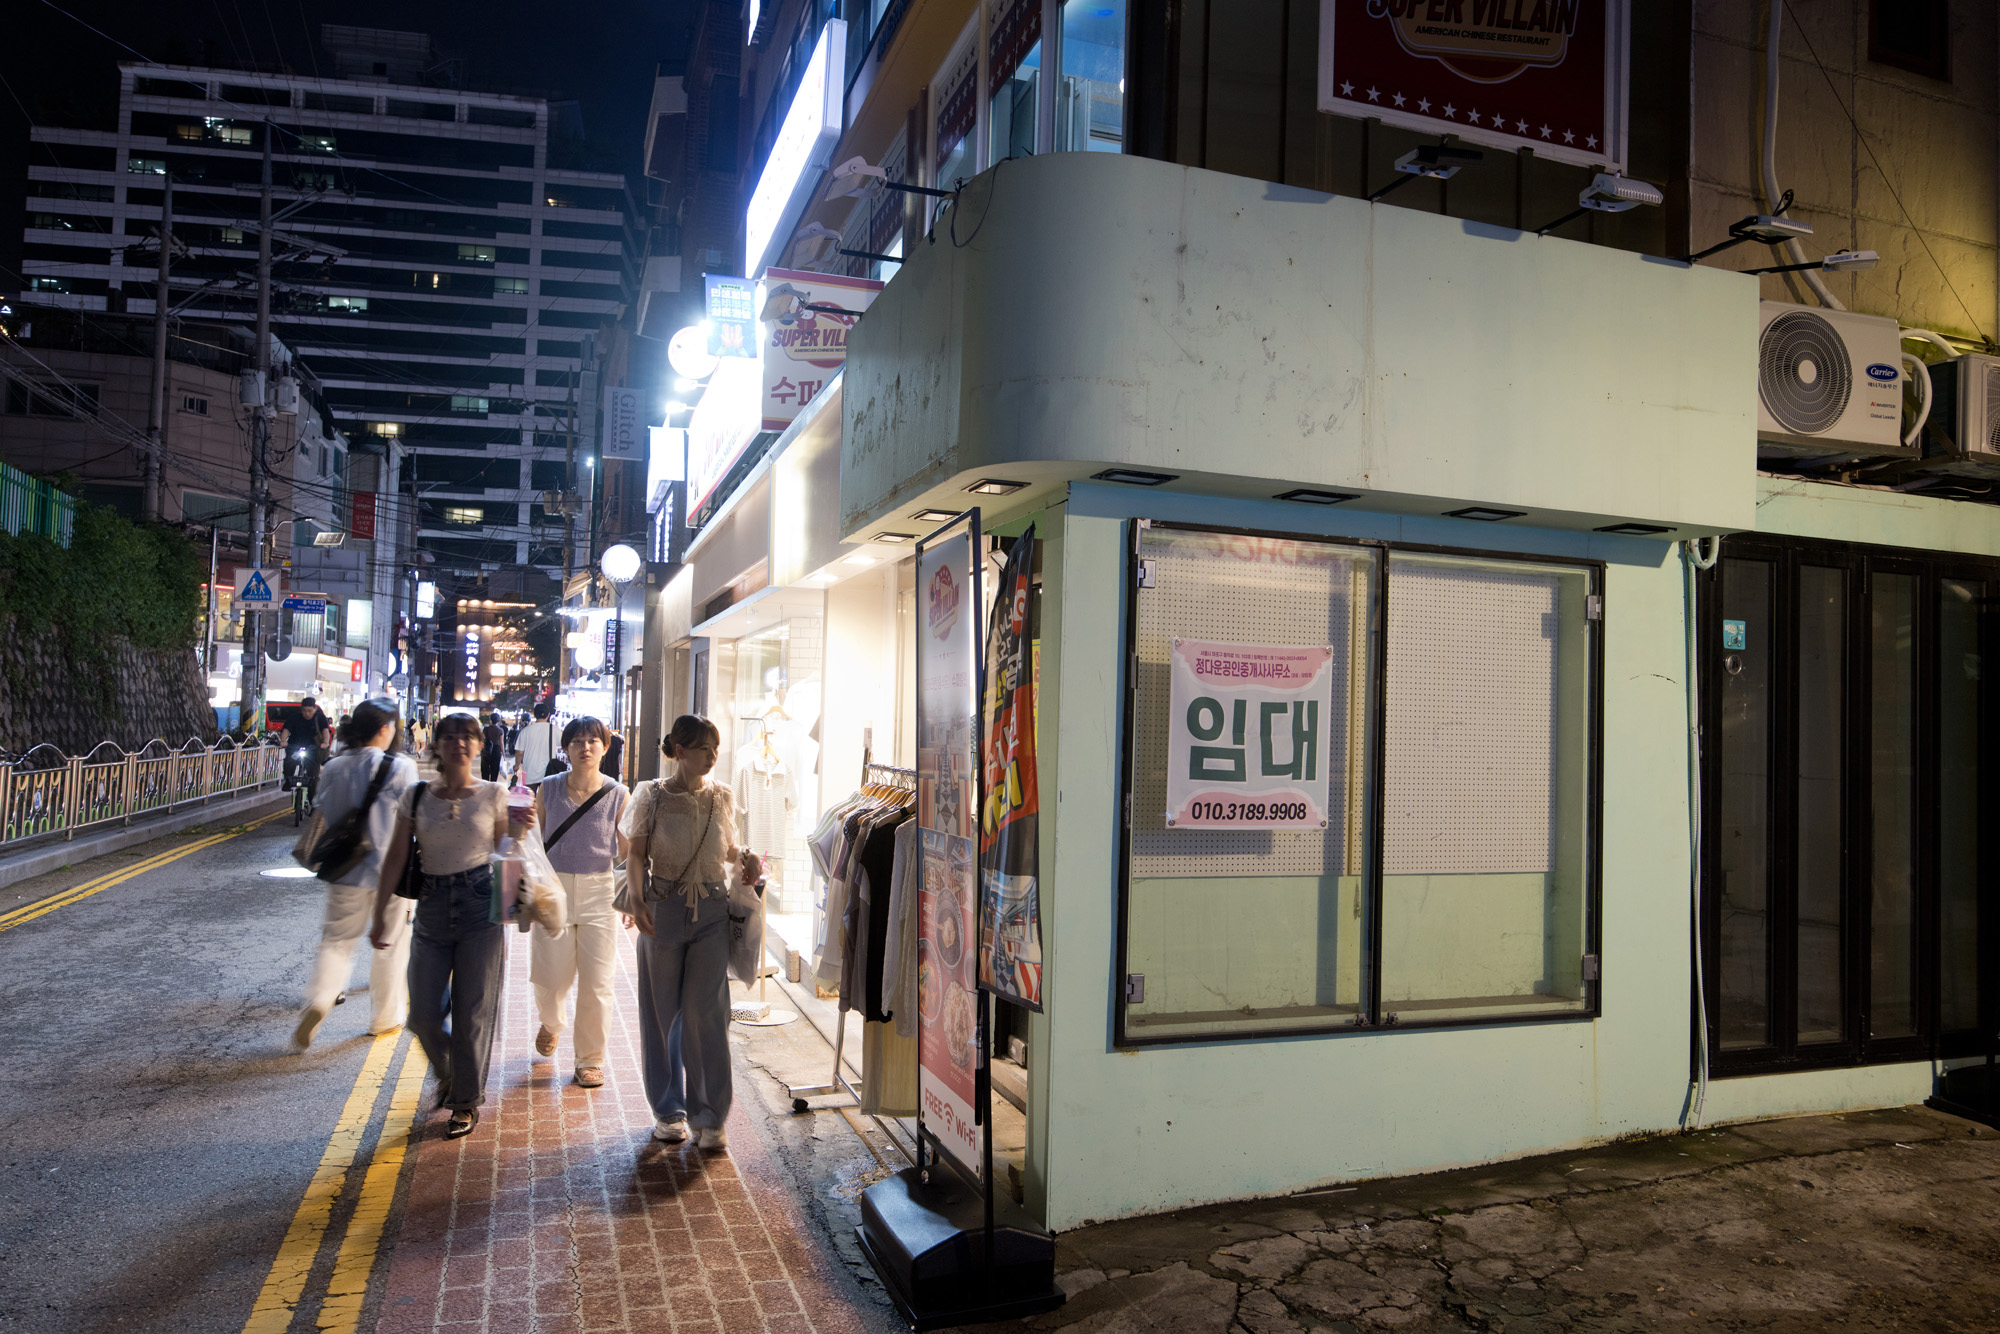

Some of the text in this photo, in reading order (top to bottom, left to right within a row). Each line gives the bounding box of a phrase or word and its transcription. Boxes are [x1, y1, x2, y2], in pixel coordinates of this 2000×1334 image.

[1415, 25, 1551, 46] AMERICAN CHINESE RESTAURANT
[772, 329, 820, 347] SUPER
[1870, 367, 1895, 377] Carrier
[619, 393, 636, 451] Glitch
[1195, 657, 1291, 679] 정다운공인중개사사무소
[1186, 696, 1319, 781] 임대
[1191, 802, 1307, 821] 010.3189.9908
[924, 1087, 977, 1151] FREE Wi-Fi
